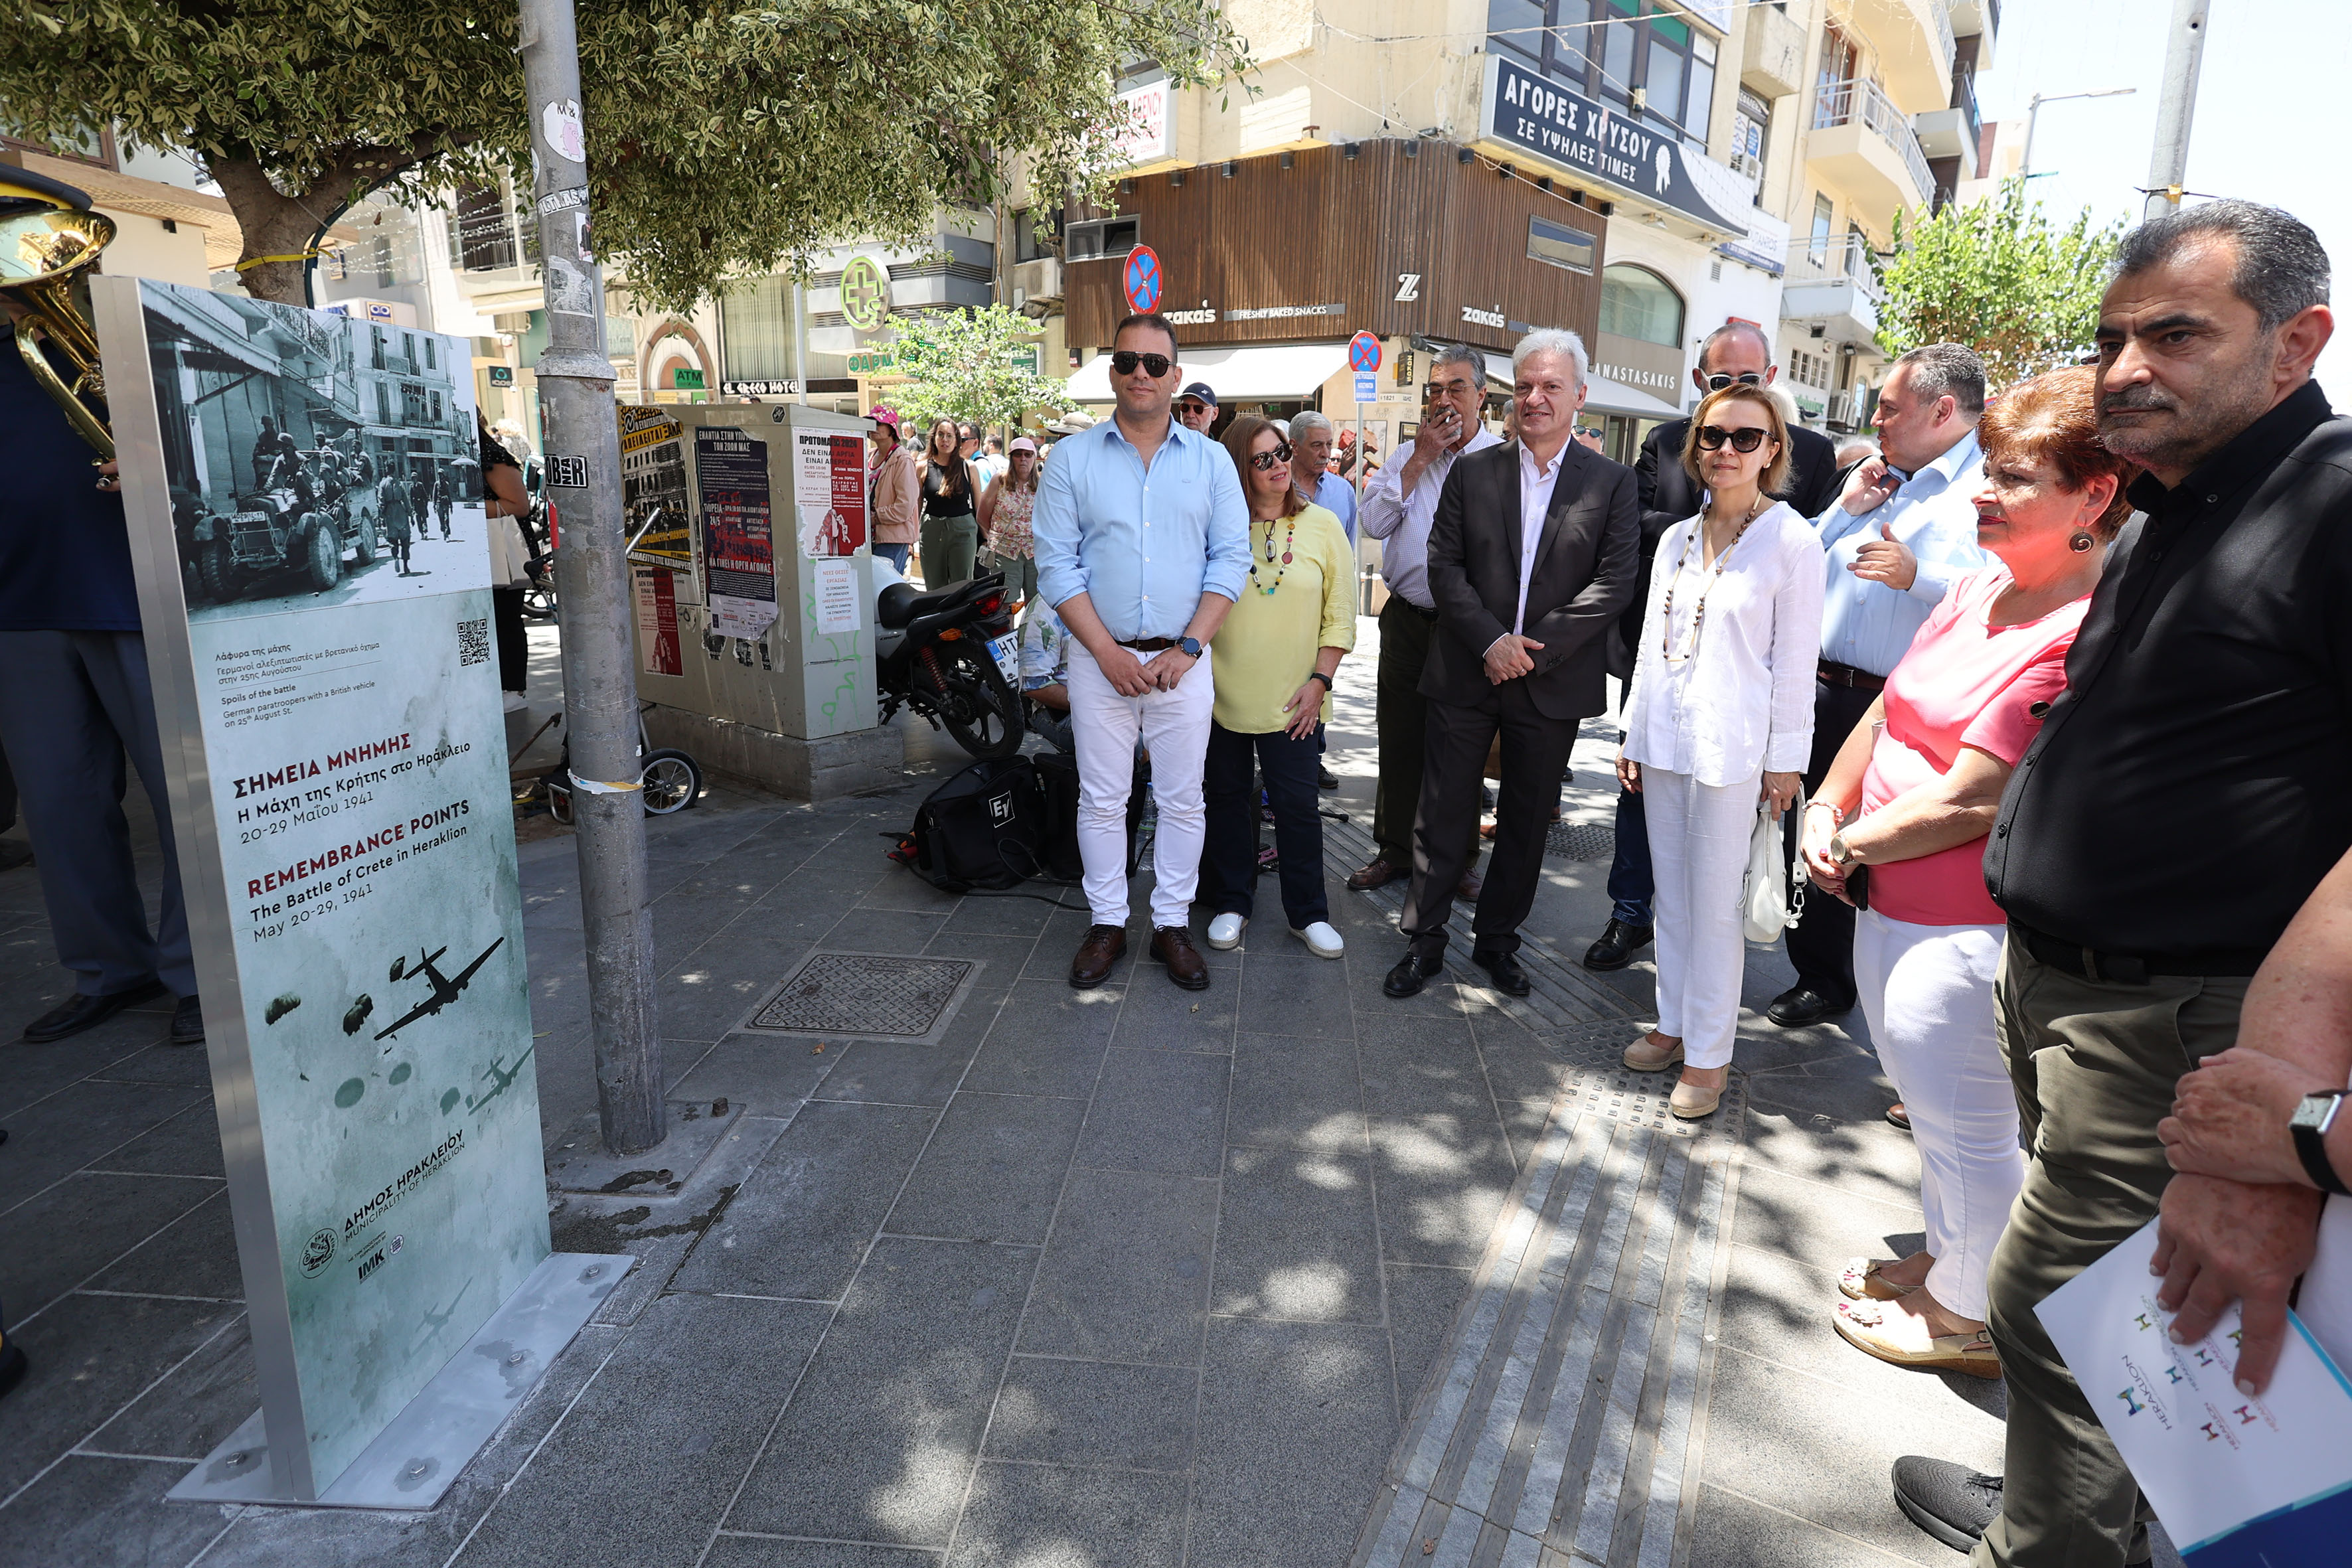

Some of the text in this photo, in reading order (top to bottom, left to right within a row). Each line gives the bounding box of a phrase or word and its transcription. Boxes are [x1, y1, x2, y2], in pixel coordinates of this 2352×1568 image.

[1504, 73, 1651, 163] ΑΓΟΡΕΣ ΧΡΥΣΟΥ
[1516, 118, 1637, 183] ΣΕ ΥΨΗΛΕΣ ΤΙΜΕΣ
[1239, 309, 1268, 319] FRESHLY
[1269, 308, 1293, 317] BAKED
[1294, 306, 1326, 316] SNACKS
[677, 370, 702, 382] ATM
[723, 381, 799, 394] EL GRECO HOTEL
[1595, 362, 1676, 390] ANASTASAKIS
[699, 431, 734, 440] ΕΝΑΝΤΙΑ ΣΤΗΝ
[738, 442, 750, 451] ΜΑΣ
[627, 551, 655, 563] ΛΗΛΕΓΓΥΗ
[215, 643, 291, 662] Λάφυρα της μάχης
[217, 642, 380, 676] Γερμανοί αλεξιπτωτιστές με βρετανικό όχημα
[998, 635, 1018, 656] HT
[218, 665, 302, 685] στην 25ης Αυγούστου
[221, 684, 296, 706] Spoils of the battle
[223, 707, 256, 719] German
[257, 696, 306, 714] paratroopers
[307, 690, 323, 700] with
[331, 685, 351, 696] British
[353, 680, 376, 691] vehicle
[224, 720, 236, 728] on
[254, 710, 281, 723] August
[283, 707, 293, 716] St.
[233, 732, 411, 799] ΣΗΜΕΙΑ ΜΝΗΜΗΣ
[238, 742, 470, 823] Η Μάχη της Κρήτης στο Ηράκλειο
[241, 820, 287, 844] 20-29
[345, 791, 374, 809] 1941
[248, 800, 469, 898] REMEMBRANCE POINTS
[250, 826, 467, 922] The Battle of Crete in Heraklion
[254, 883, 372, 942] May 20-29, 1941
[345, 1129, 463, 1232] ΔΗΜΟΣ ΗΡΑΚΛΕΙΟΥ
[345, 1142, 465, 1243] MUNICIPALITY OF HERAKLION
[2122, 1355, 2172, 1430] HERAKLION
